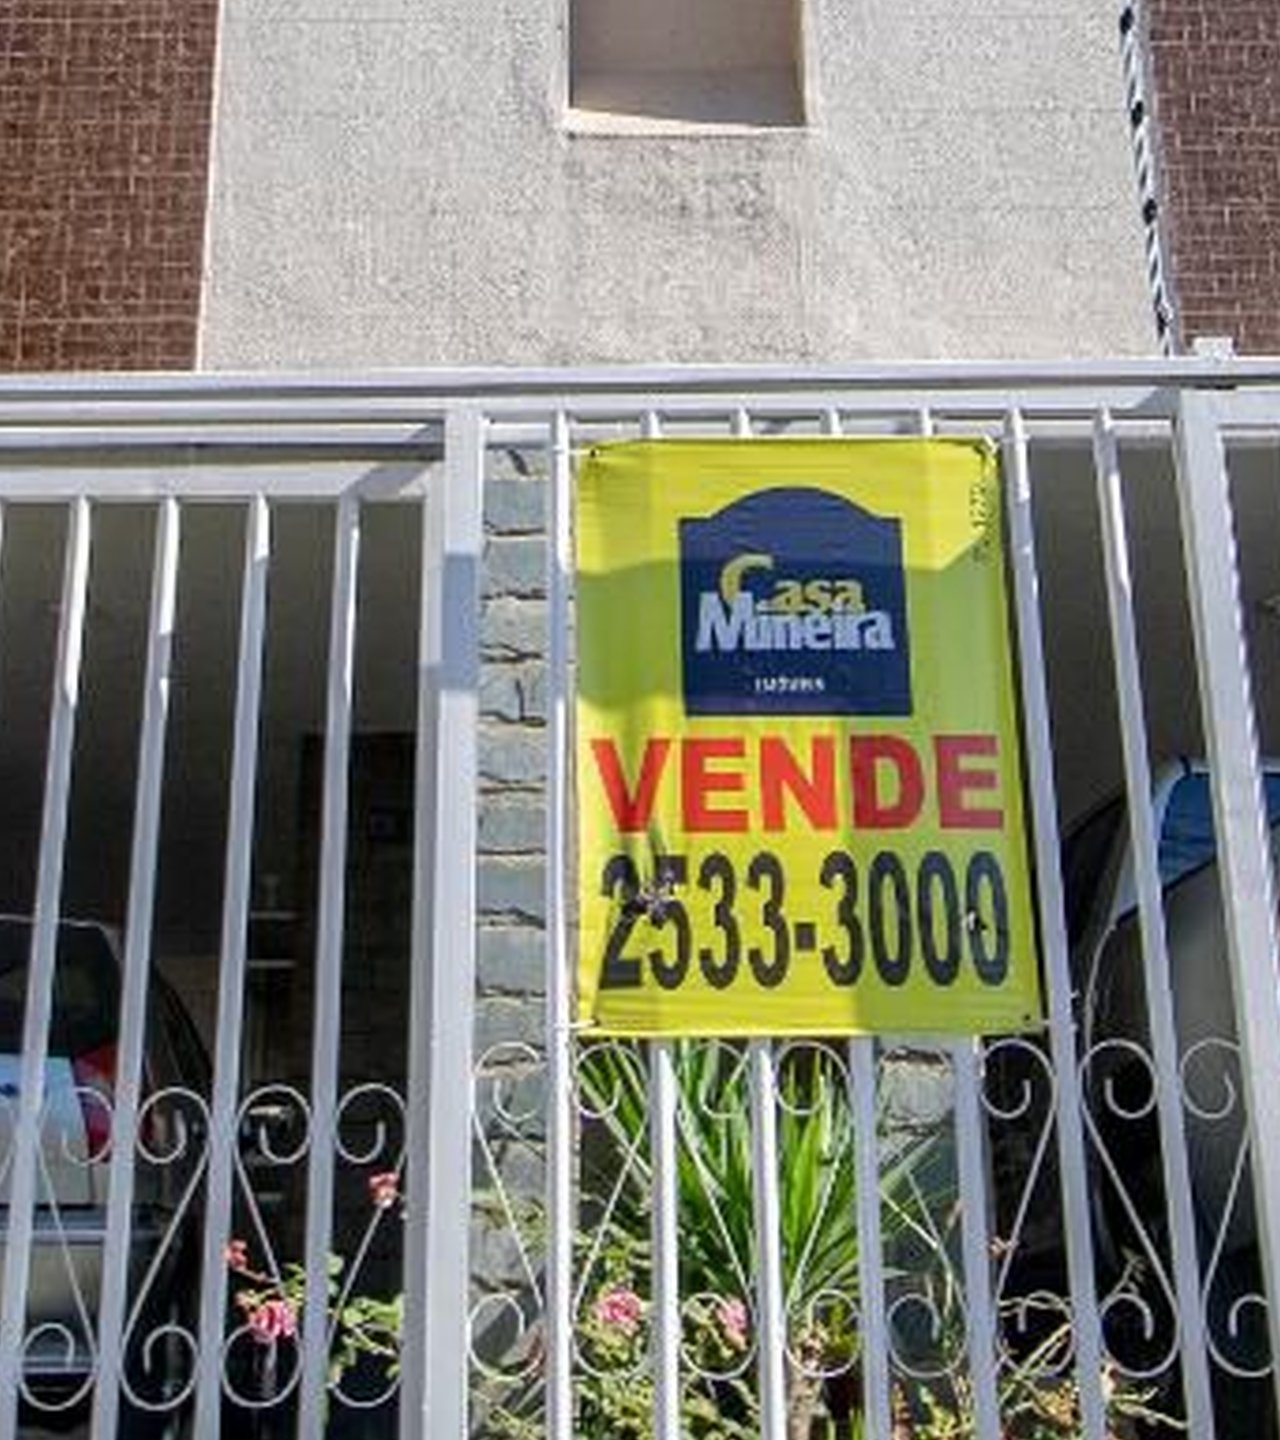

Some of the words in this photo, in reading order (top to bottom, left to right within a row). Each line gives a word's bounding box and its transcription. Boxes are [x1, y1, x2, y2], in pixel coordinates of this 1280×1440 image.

[696, 592, 895, 651] Mineira
[720, 553, 866, 613] Casa
[591, 734, 1005, 833] VENDE
[599, 850, 1010, 990] 2533-3000
